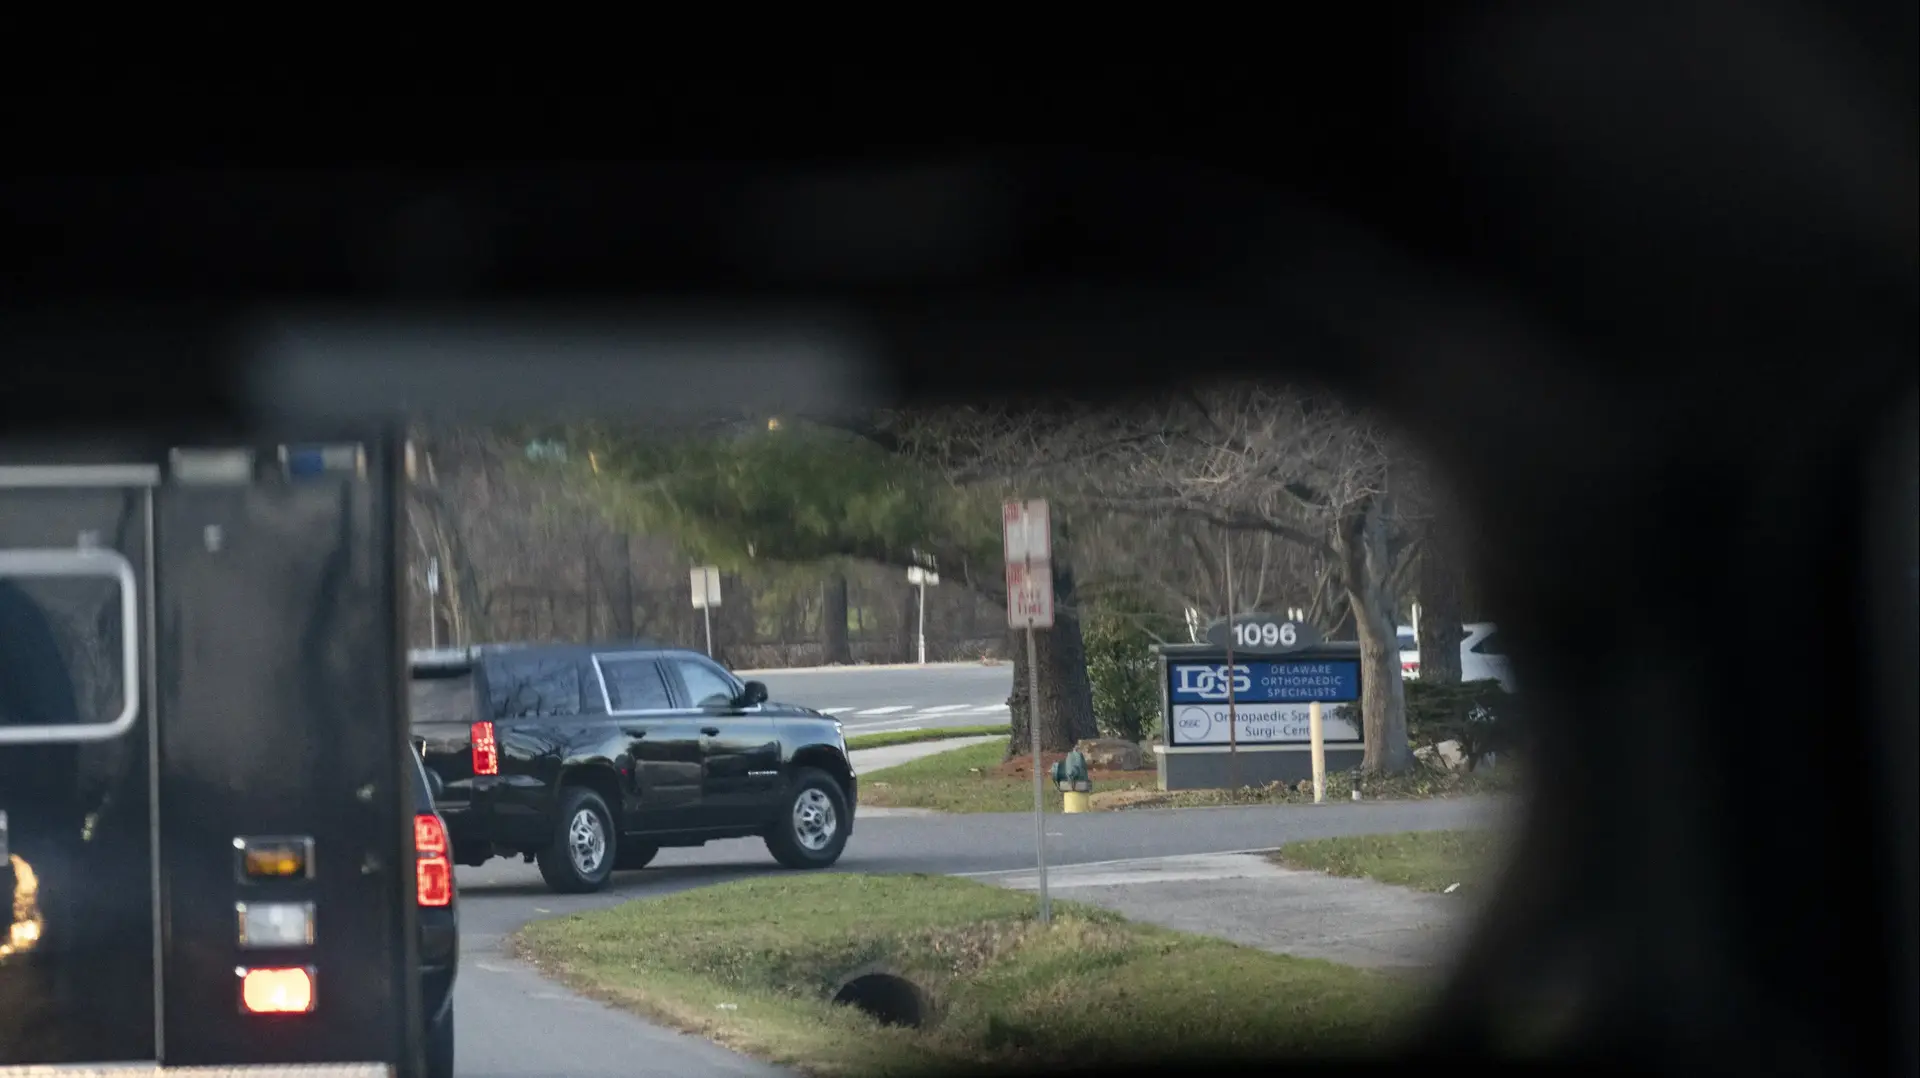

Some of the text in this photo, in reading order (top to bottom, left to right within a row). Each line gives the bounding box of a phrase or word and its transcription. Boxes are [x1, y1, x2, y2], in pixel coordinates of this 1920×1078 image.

[1233, 622, 1297, 647] 1096
[1271, 664, 1333, 674] DELAWARE
[1261, 676, 1342, 686] ORTHOPAEDIC
[1267, 687, 1337, 698] SPECIALISTS
[1214, 710, 1287, 724] Orhopaedic
